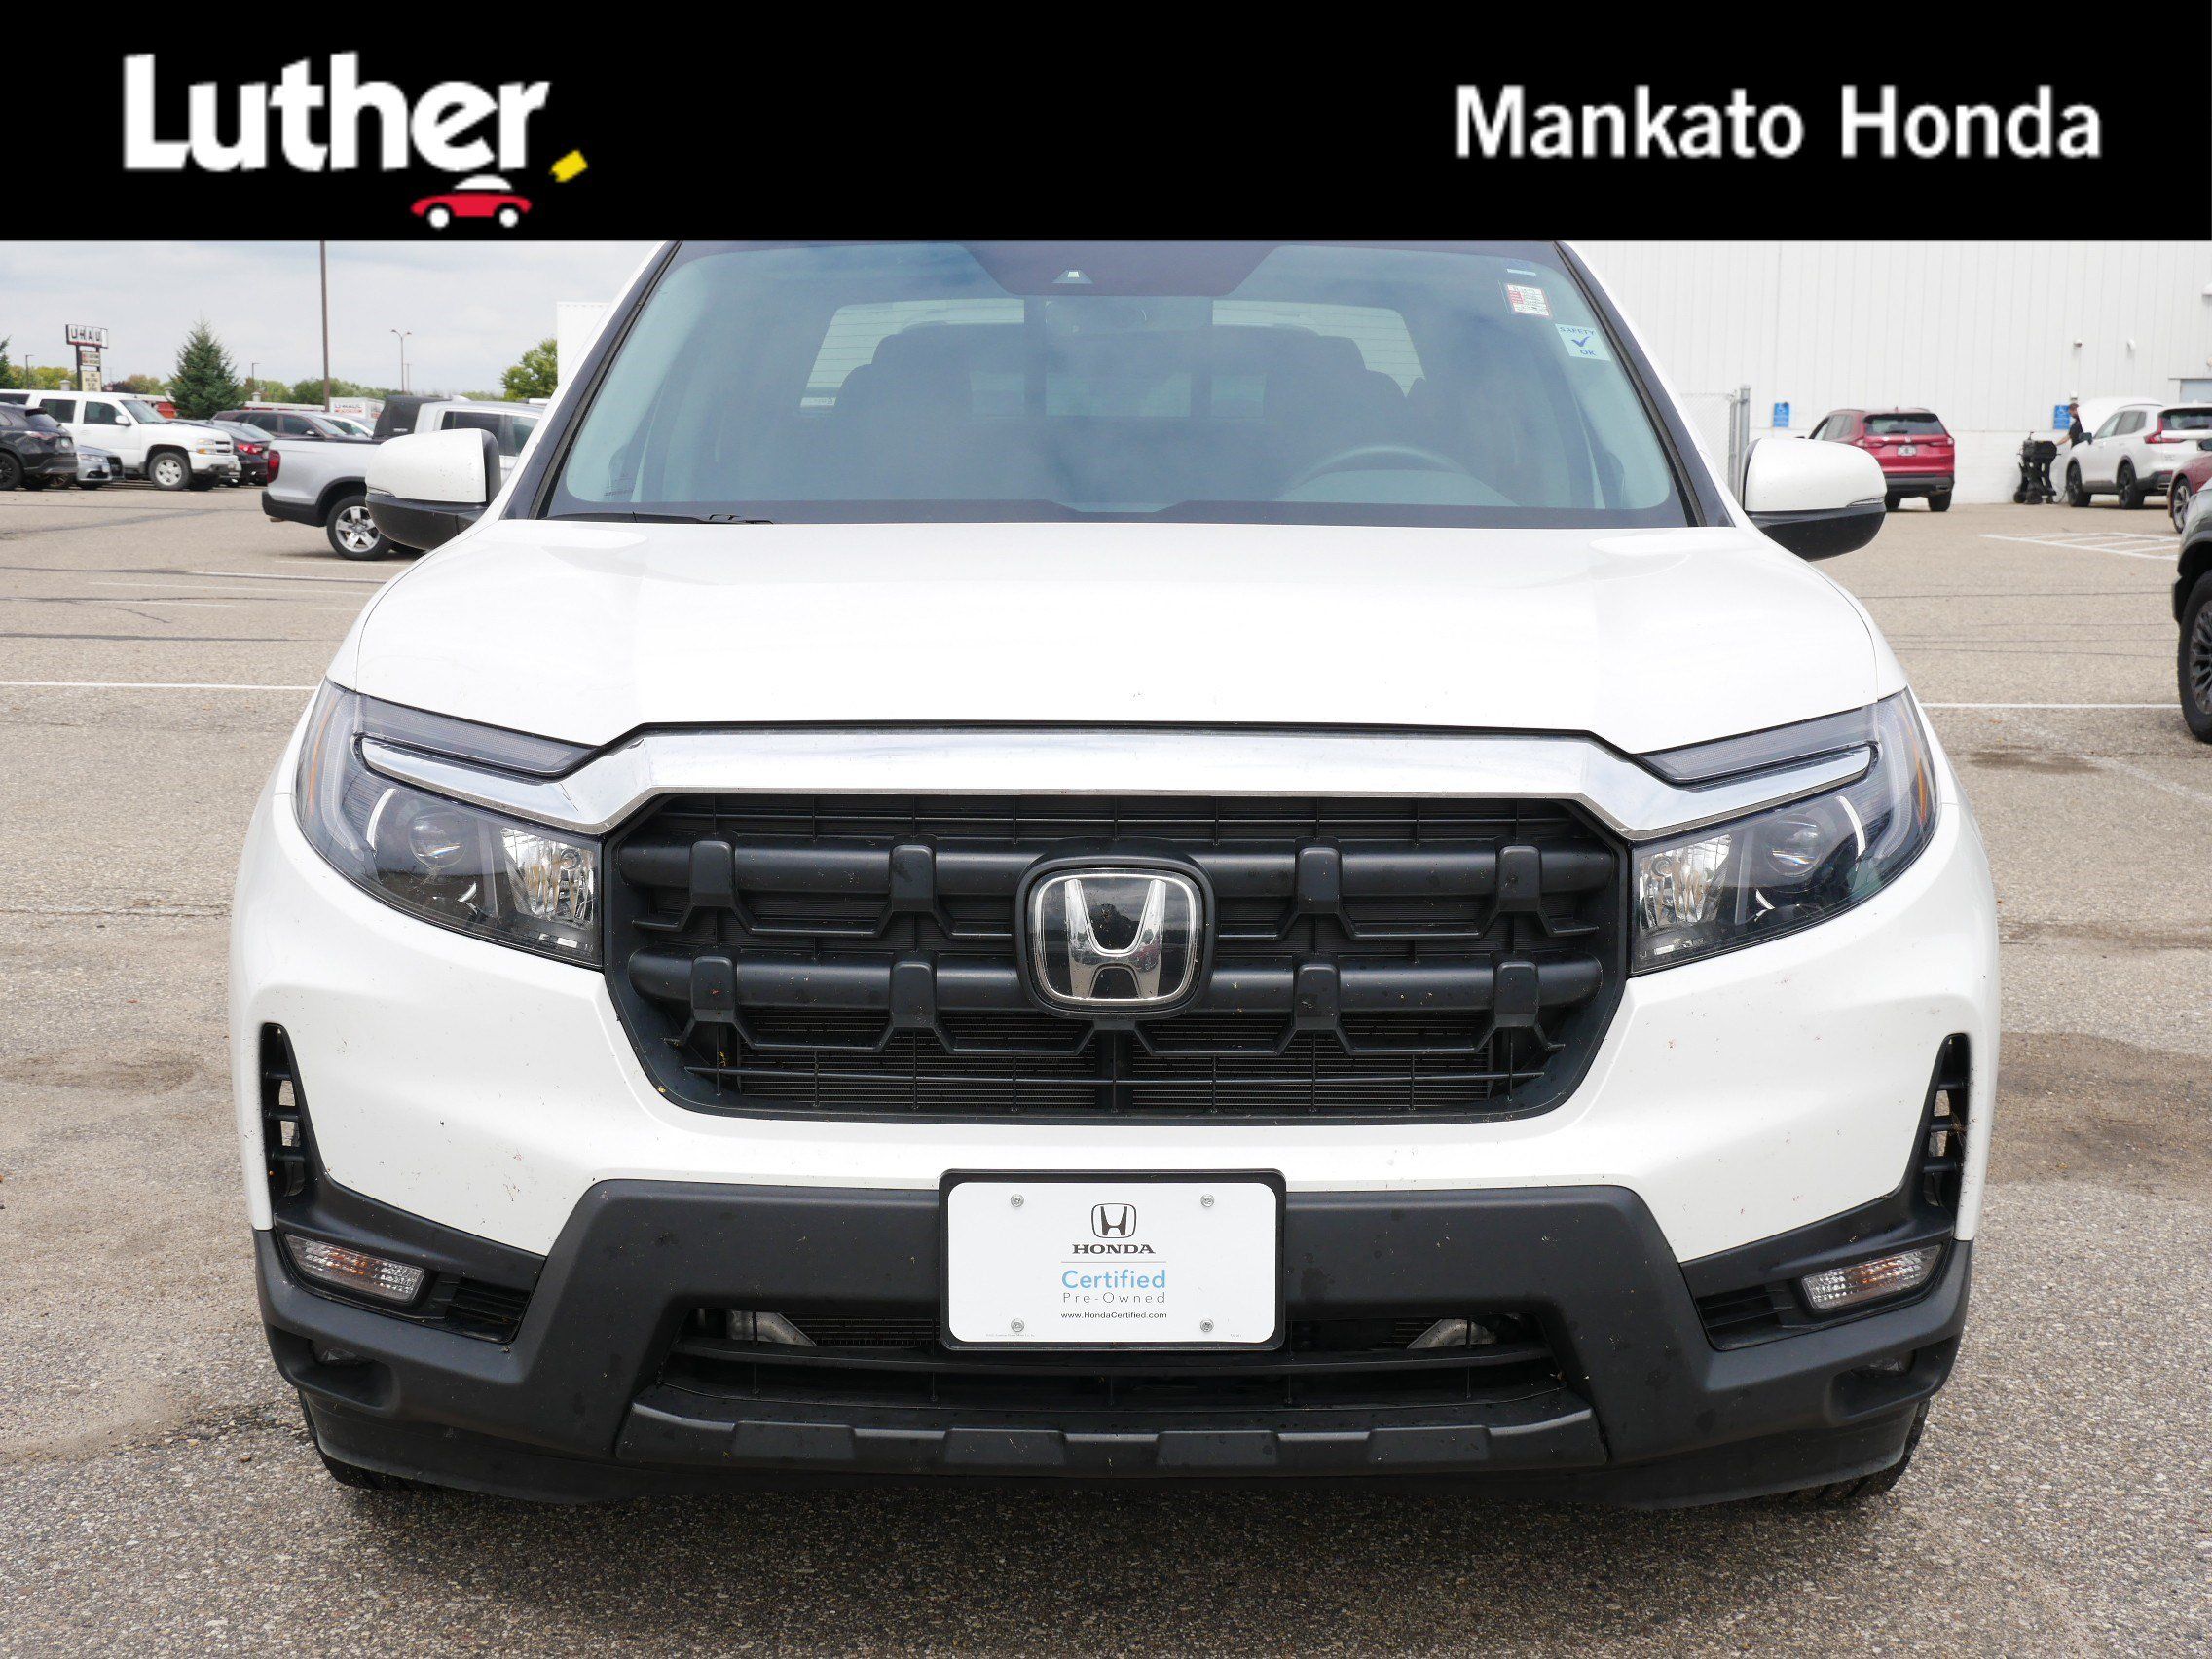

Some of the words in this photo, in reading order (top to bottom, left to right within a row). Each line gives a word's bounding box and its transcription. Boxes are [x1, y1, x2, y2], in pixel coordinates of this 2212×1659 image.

[1559, 326, 1595, 335] SAFETY
[1072, 1243, 1157, 1255] HONDA
[1061, 1269, 1165, 1288] Certified
[1062, 1291, 1165, 1304] Pre-Owned
[1060, 1310, 1167, 1319] www.HondaCertified.com
